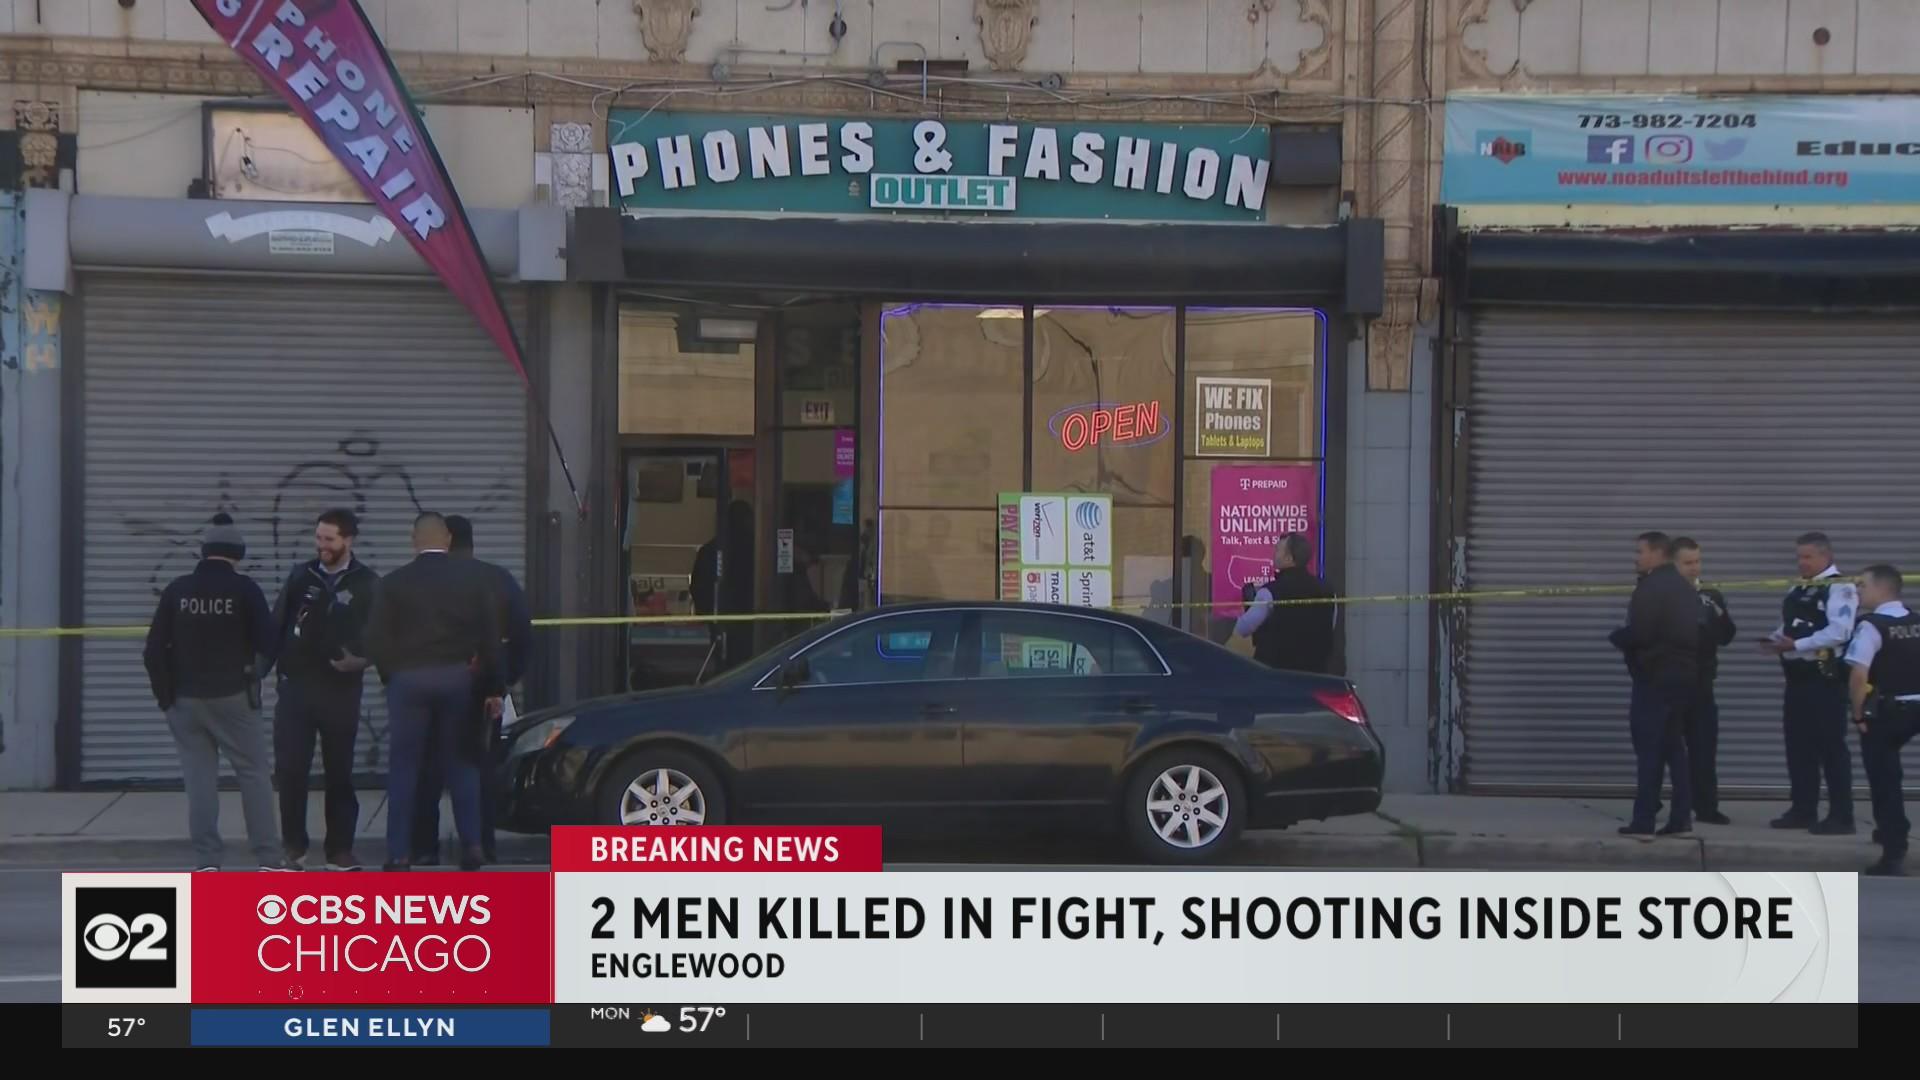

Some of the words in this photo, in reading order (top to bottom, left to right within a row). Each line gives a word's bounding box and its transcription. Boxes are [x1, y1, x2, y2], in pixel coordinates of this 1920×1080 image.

[275, 0, 414, 154] PHONE
[252, 22, 446, 241] REPAIR
[1578, 113, 1757, 129] 773-982-7204
[611, 121, 875, 198] PHONES
[912, 119, 953, 174] &
[987, 123, 1270, 211] FASHION
[875, 176, 1009, 206] OUTLET
[1204, 386, 1233, 410] WE
[1236, 386, 1264, 410] FIX
[1061, 400, 1160, 451] OPEN
[1205, 412, 1262, 431] Phones
[1201, 434, 1228, 448] Tablets
[1235, 434, 1265, 449] Laptops
[1252, 479, 1288, 490] PREPAID
[1033, 502, 1042, 538] verizon
[1220, 504, 1308, 518] NATIONWIDE
[1219, 518, 1309, 533] UNLIMITED
[1083, 532, 1096, 561] at&t
[1220, 536, 1242, 547] Talk,
[1244, 536, 1262, 546] Text
[180, 597, 234, 616] POLICE
